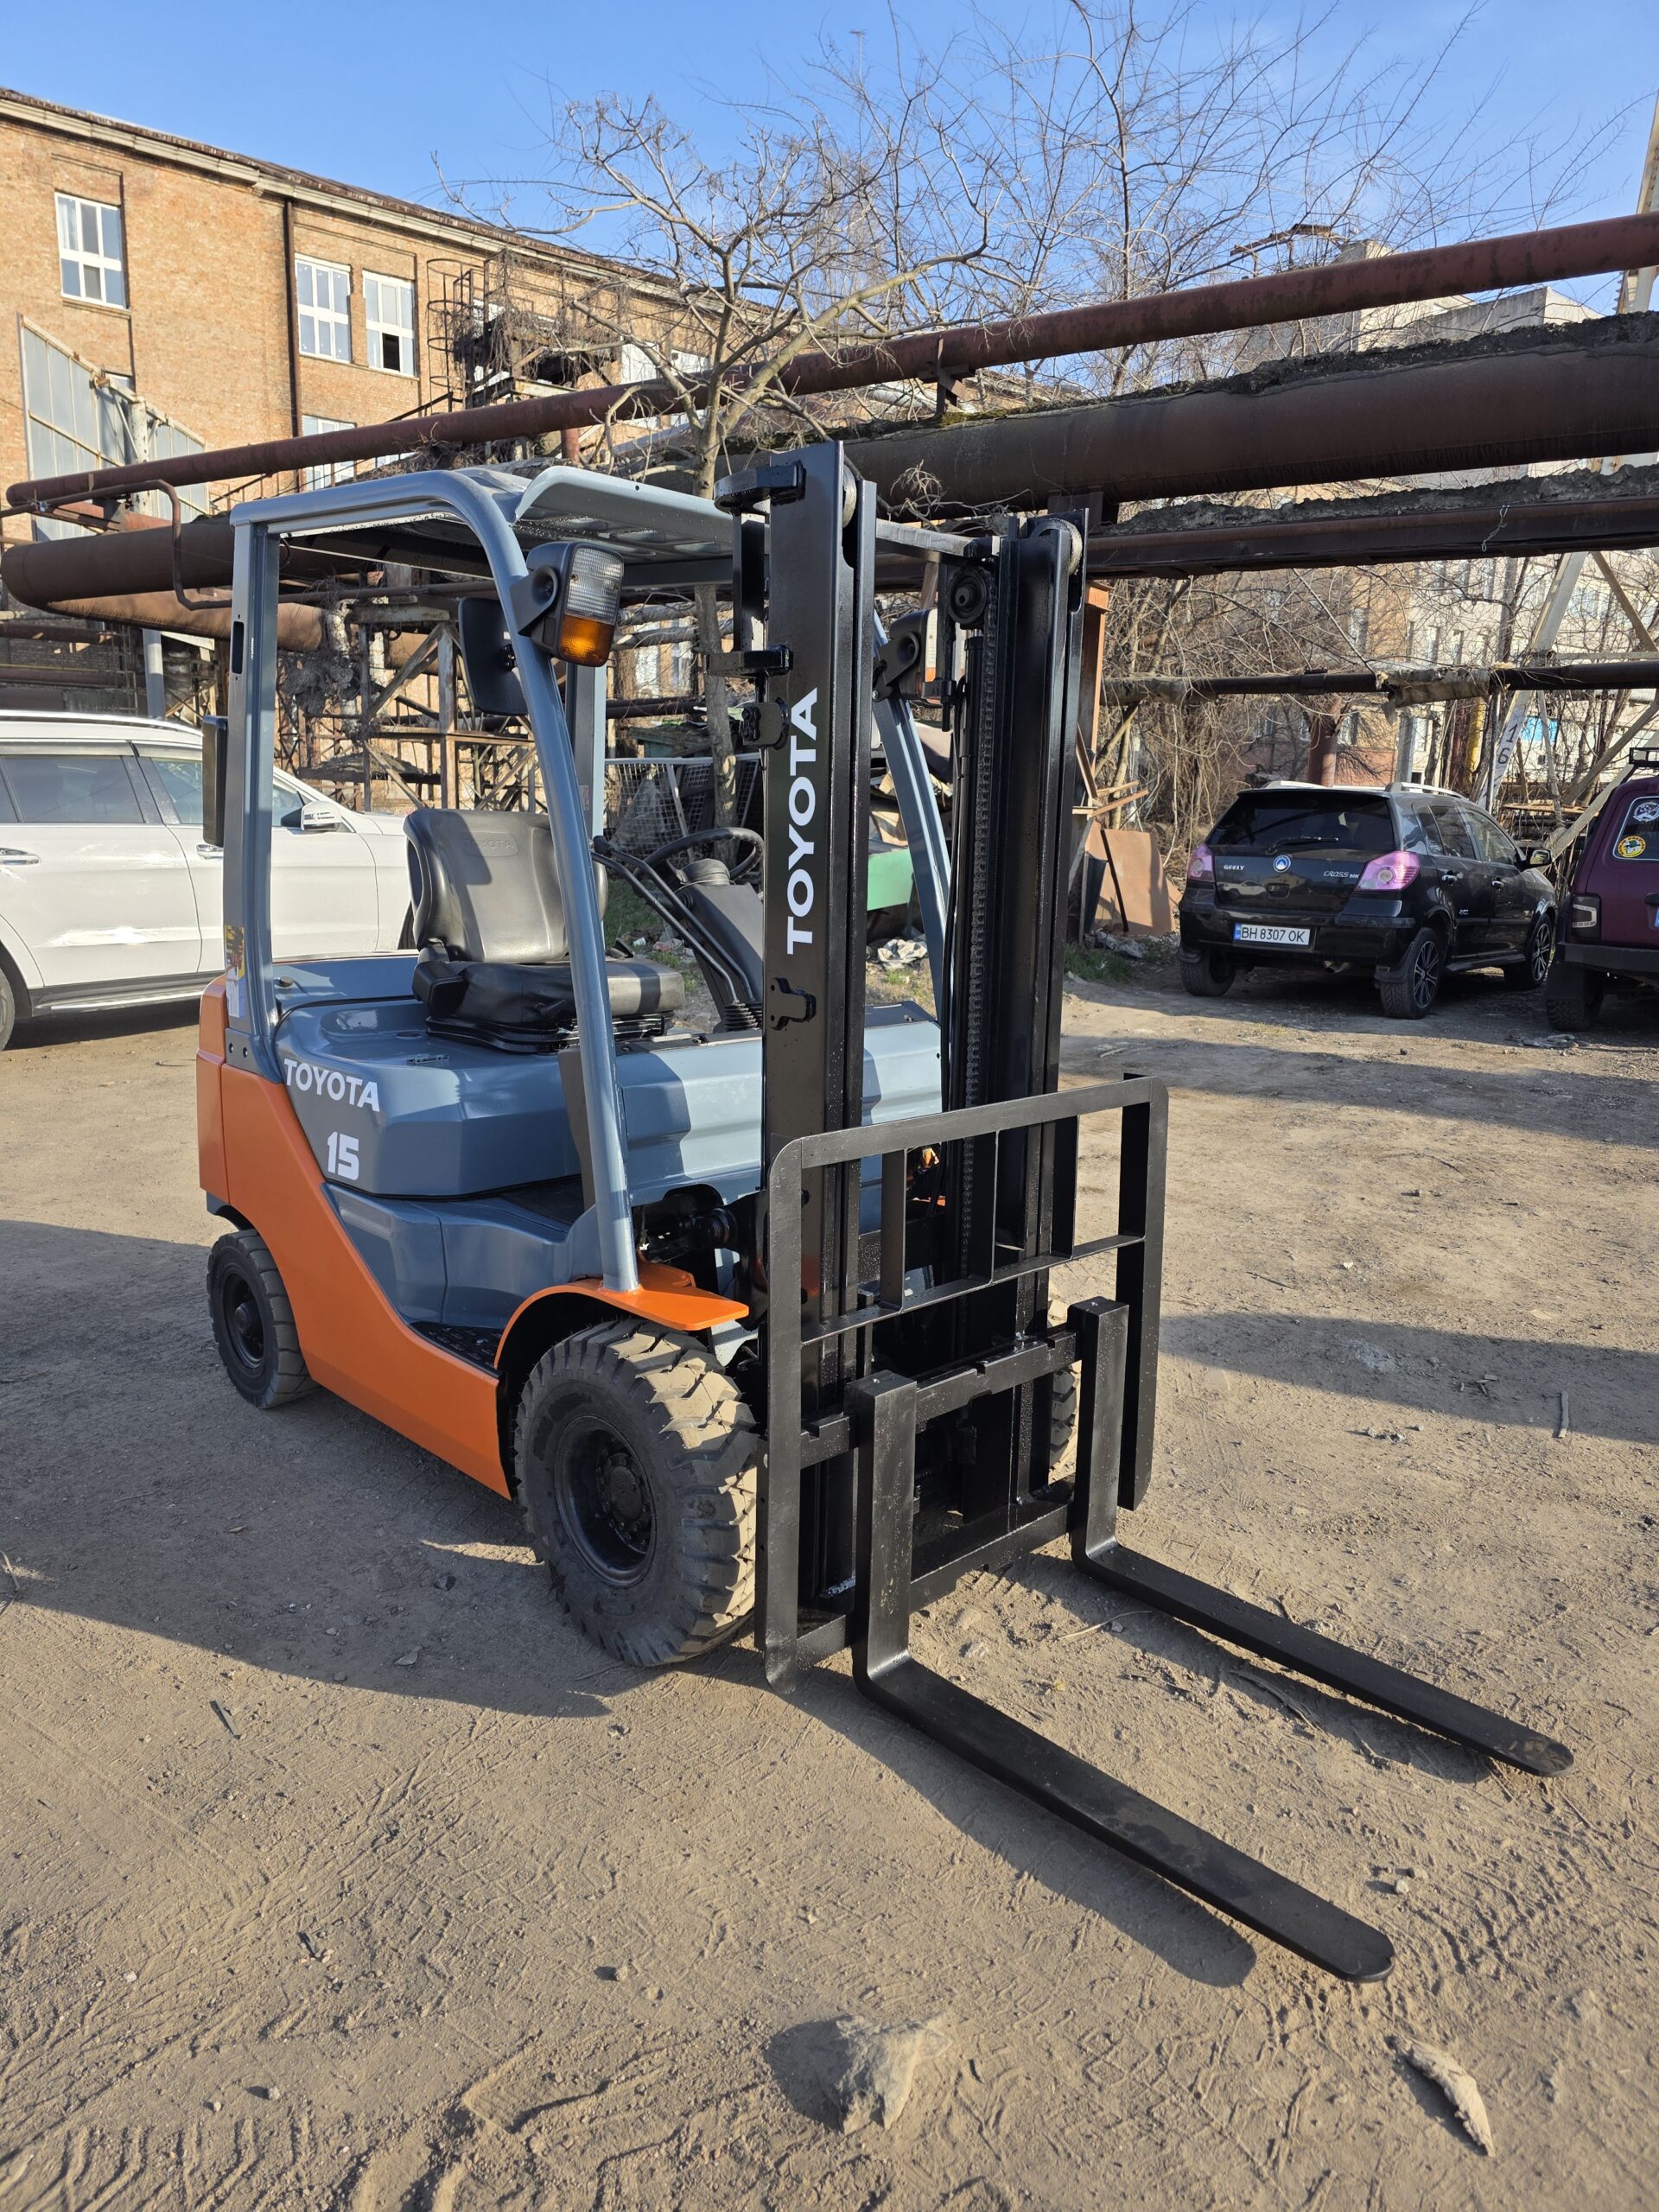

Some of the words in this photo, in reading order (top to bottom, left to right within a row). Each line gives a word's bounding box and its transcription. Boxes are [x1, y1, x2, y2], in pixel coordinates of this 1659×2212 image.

[787, 688, 817, 955] TOYOTA
[1241, 927, 1258, 939] BH
[1260, 928, 1287, 941] 8307
[1288, 930, 1306, 943] OK
[283, 1058, 380, 1113] TOYOTA
[327, 1131, 359, 1181] 15
